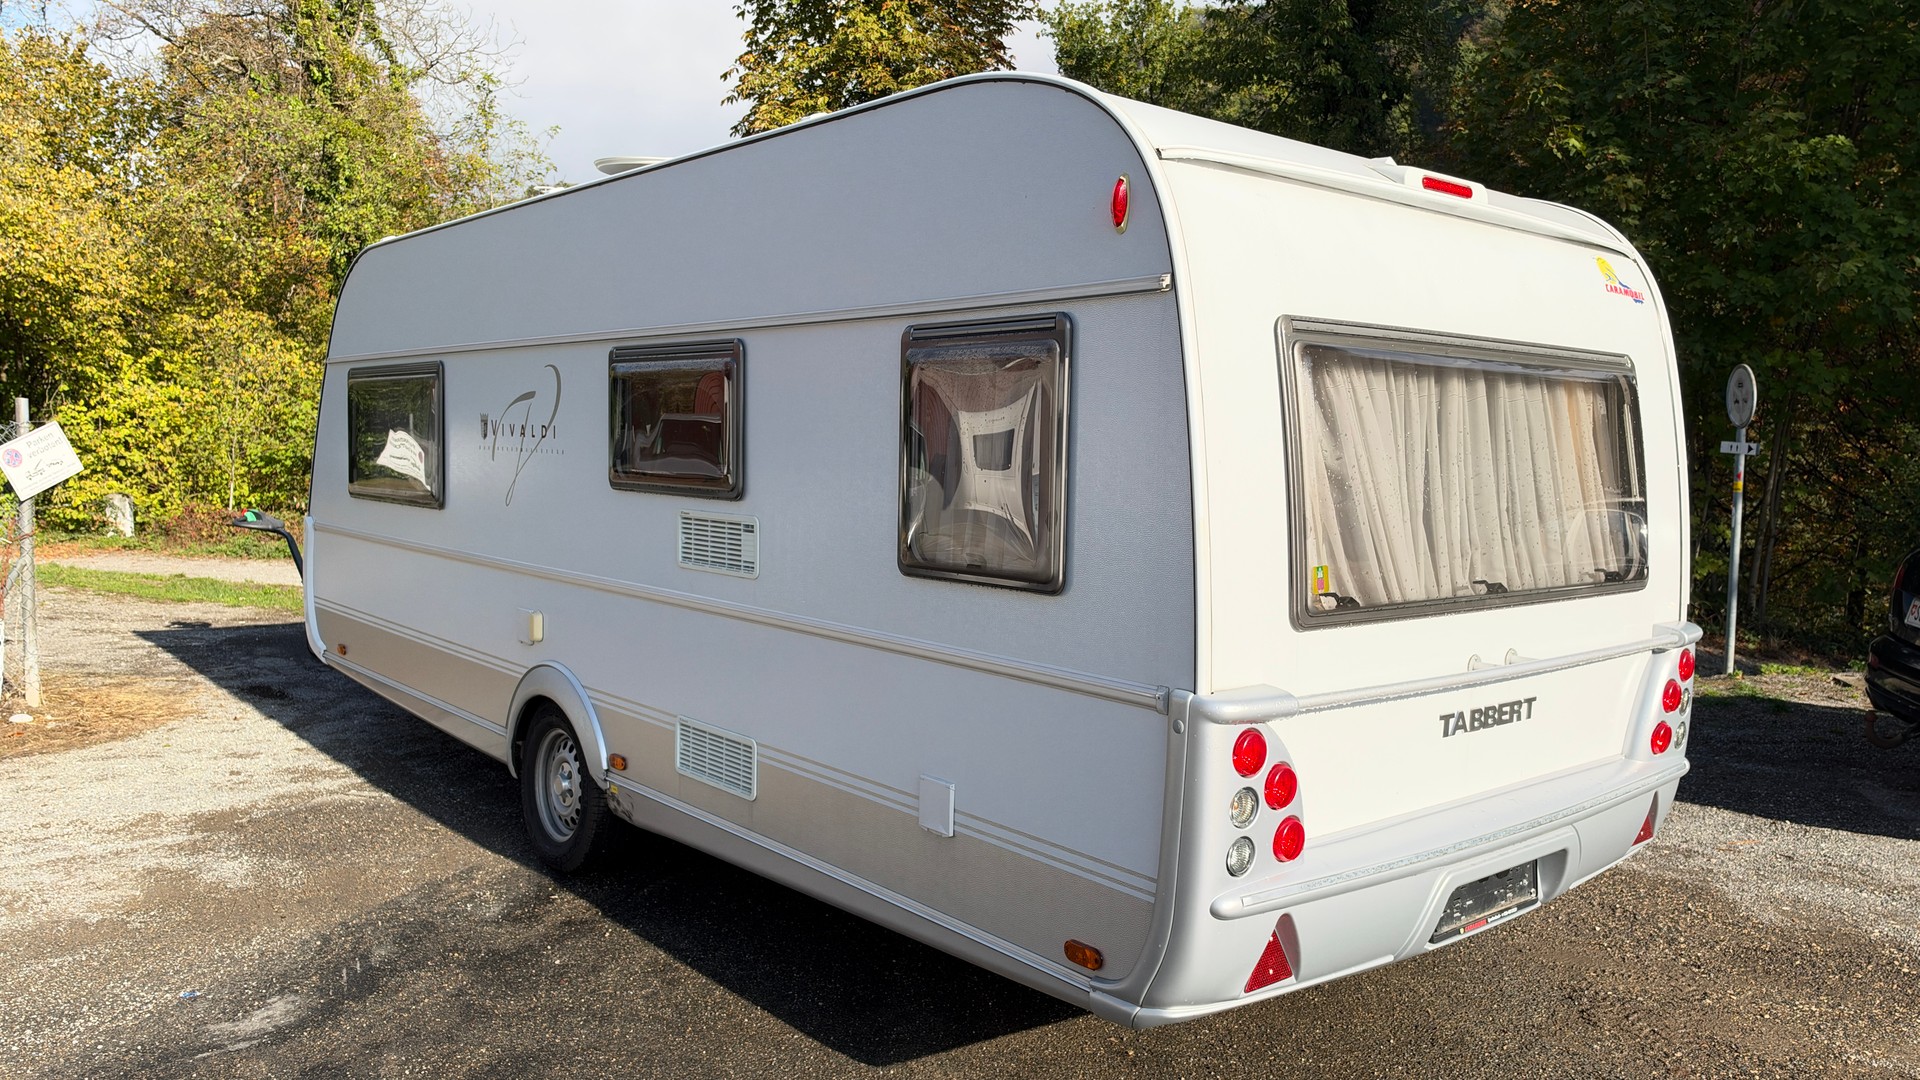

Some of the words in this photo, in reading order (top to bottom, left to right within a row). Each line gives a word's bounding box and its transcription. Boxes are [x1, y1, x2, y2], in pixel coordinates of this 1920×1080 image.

[1605, 283, 1645, 301] CARAMOBIL
[491, 419, 556, 439] VIVALDI
[26, 432, 54, 448] Parken
[1439, 696, 1537, 738] TABBERT
